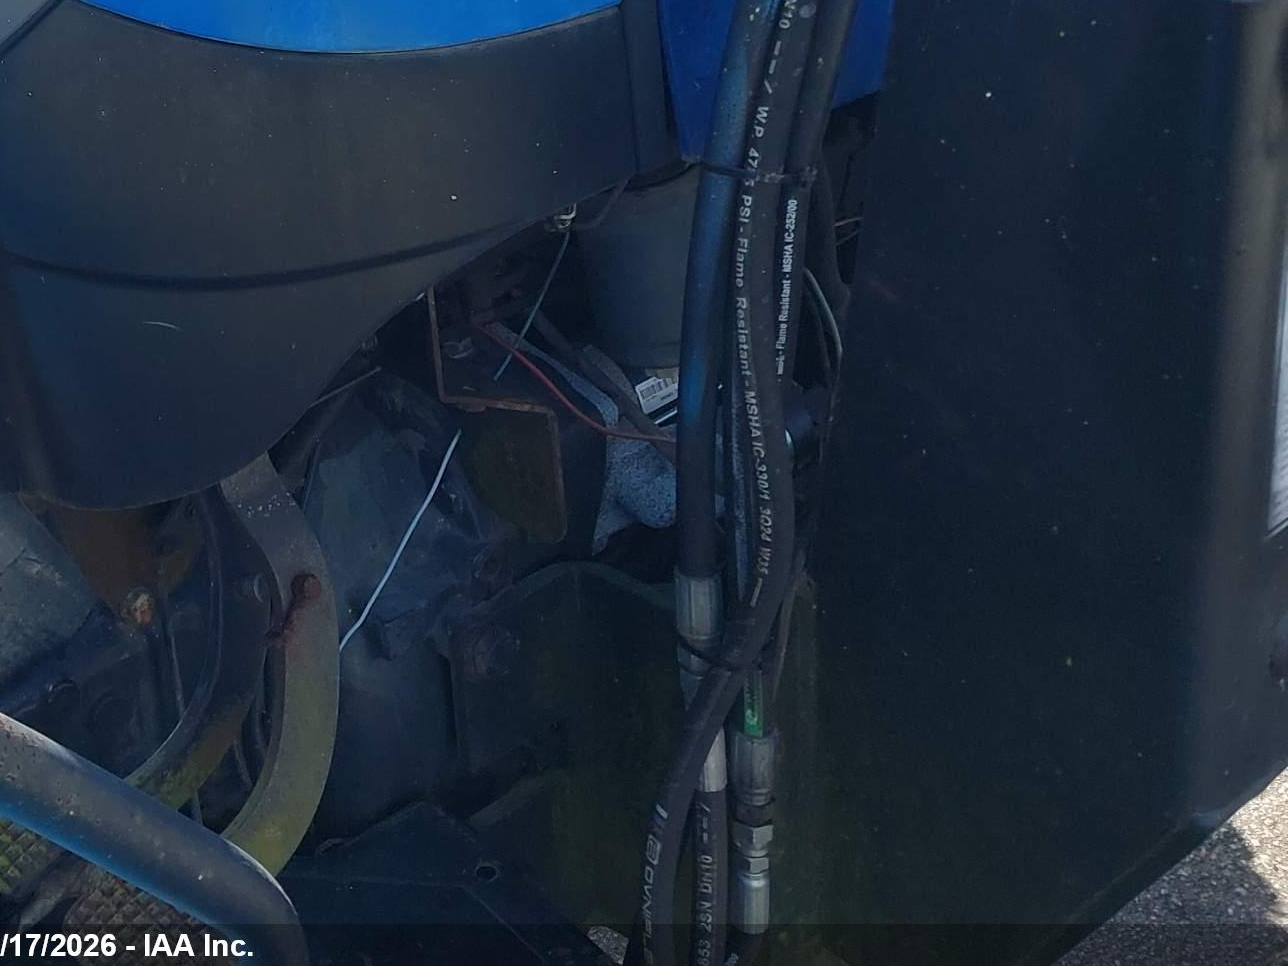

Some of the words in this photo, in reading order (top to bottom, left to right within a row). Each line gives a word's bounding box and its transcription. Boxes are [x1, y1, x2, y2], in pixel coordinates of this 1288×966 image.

[743, 147, 760, 187] 475
[738, 194, 753, 223] PSI
[734, 237, 749, 288] Flame
[781, 243, 795, 273] MSHA
[778, 279, 791, 322] Resistant
[735, 296, 752, 377] Resistant
[775, 321, 788, 350] Flame
[743, 390, 761, 439] MSHA
